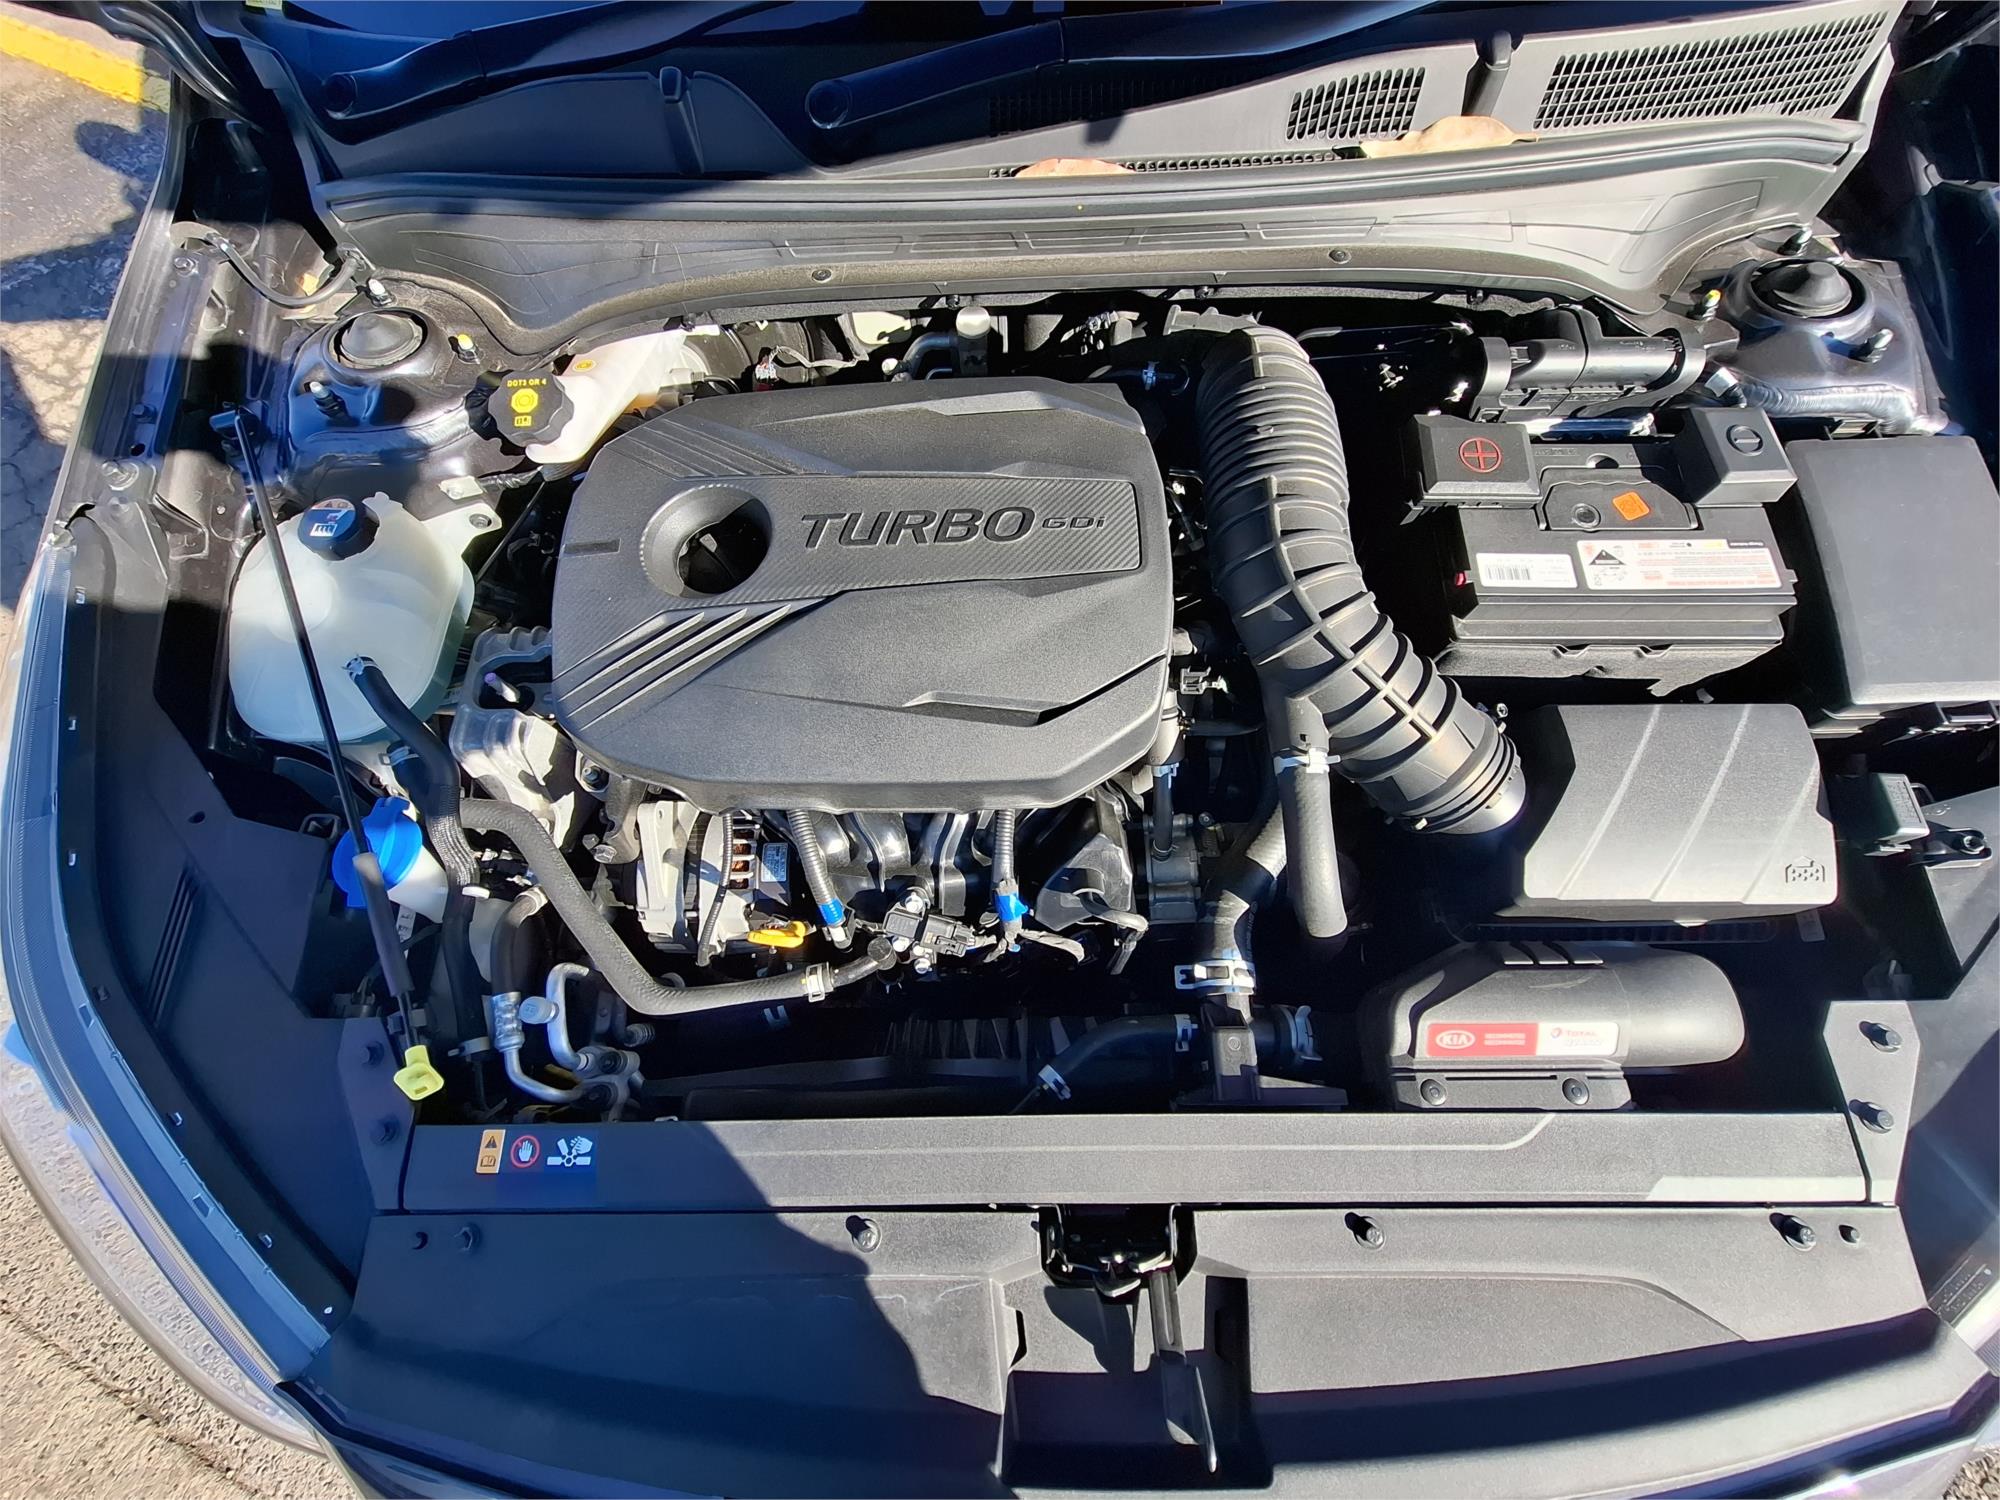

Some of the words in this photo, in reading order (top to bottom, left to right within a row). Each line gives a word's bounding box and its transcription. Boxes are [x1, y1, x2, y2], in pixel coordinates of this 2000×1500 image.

[507, 379, 527, 387] DOT3
[528, 378, 540, 386] OR
[801, 506, 1036, 550] TURBO
[1042, 516, 1106, 530] GDi
[1440, 1032, 1471, 1047] KIA
